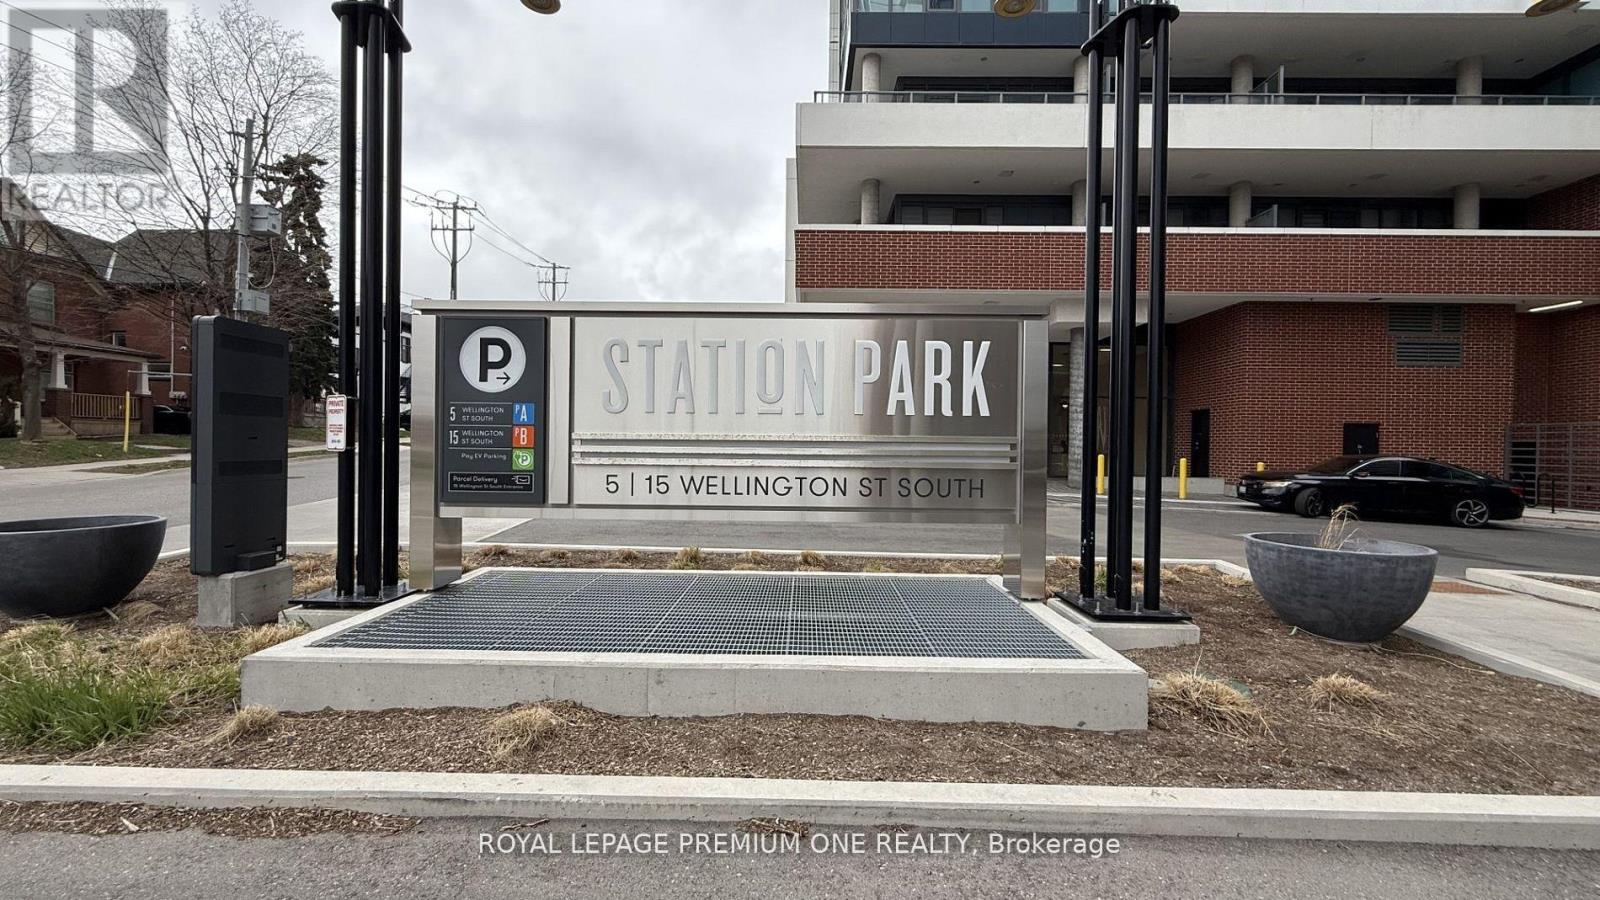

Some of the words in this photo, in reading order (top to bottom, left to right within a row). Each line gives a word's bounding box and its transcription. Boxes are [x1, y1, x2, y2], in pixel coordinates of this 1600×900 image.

[478, 337, 513, 383] P
[601, 336, 825, 416] STATION
[853, 339, 992, 418] PARK
[449, 406, 456, 421] 5
[461, 406, 504, 414] WELLINGTON
[449, 430, 459, 445] 15
[461, 452, 473, 460] Pay
[483, 452, 507, 460] Parking
[472, 475, 498, 484] Delivery
[605, 473, 619, 495] 5
[644, 473, 670, 496] 15
[679, 474, 848, 498] WELLINGTON
[858, 476, 887, 499] ST
[896, 477, 984, 499] SOUTH
